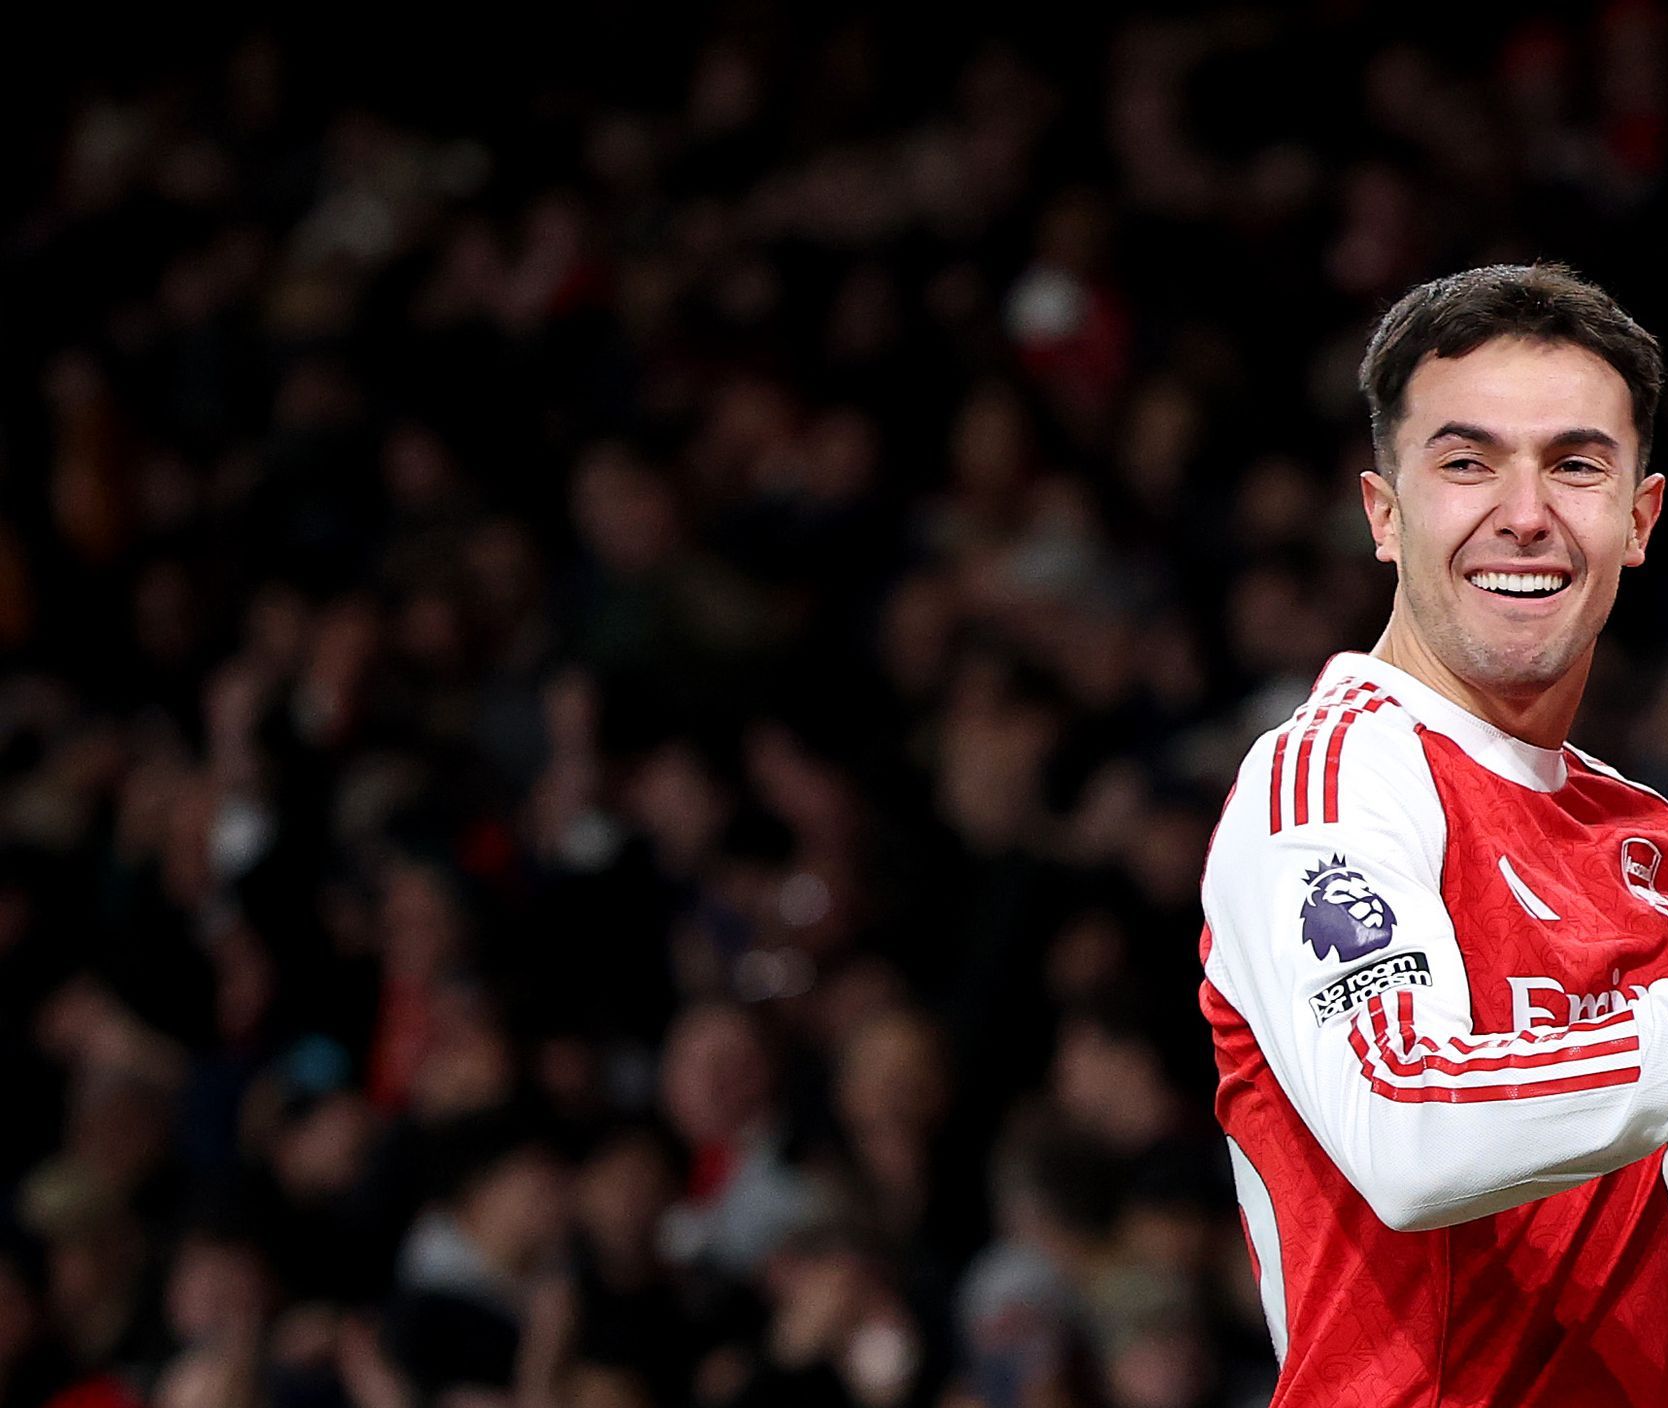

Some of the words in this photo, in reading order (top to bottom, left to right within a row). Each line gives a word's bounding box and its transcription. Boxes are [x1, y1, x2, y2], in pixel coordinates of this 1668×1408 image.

[1309, 984, 1345, 1012] No
[1346, 955, 1418, 993] room
[1349, 970, 1433, 1007] racism
